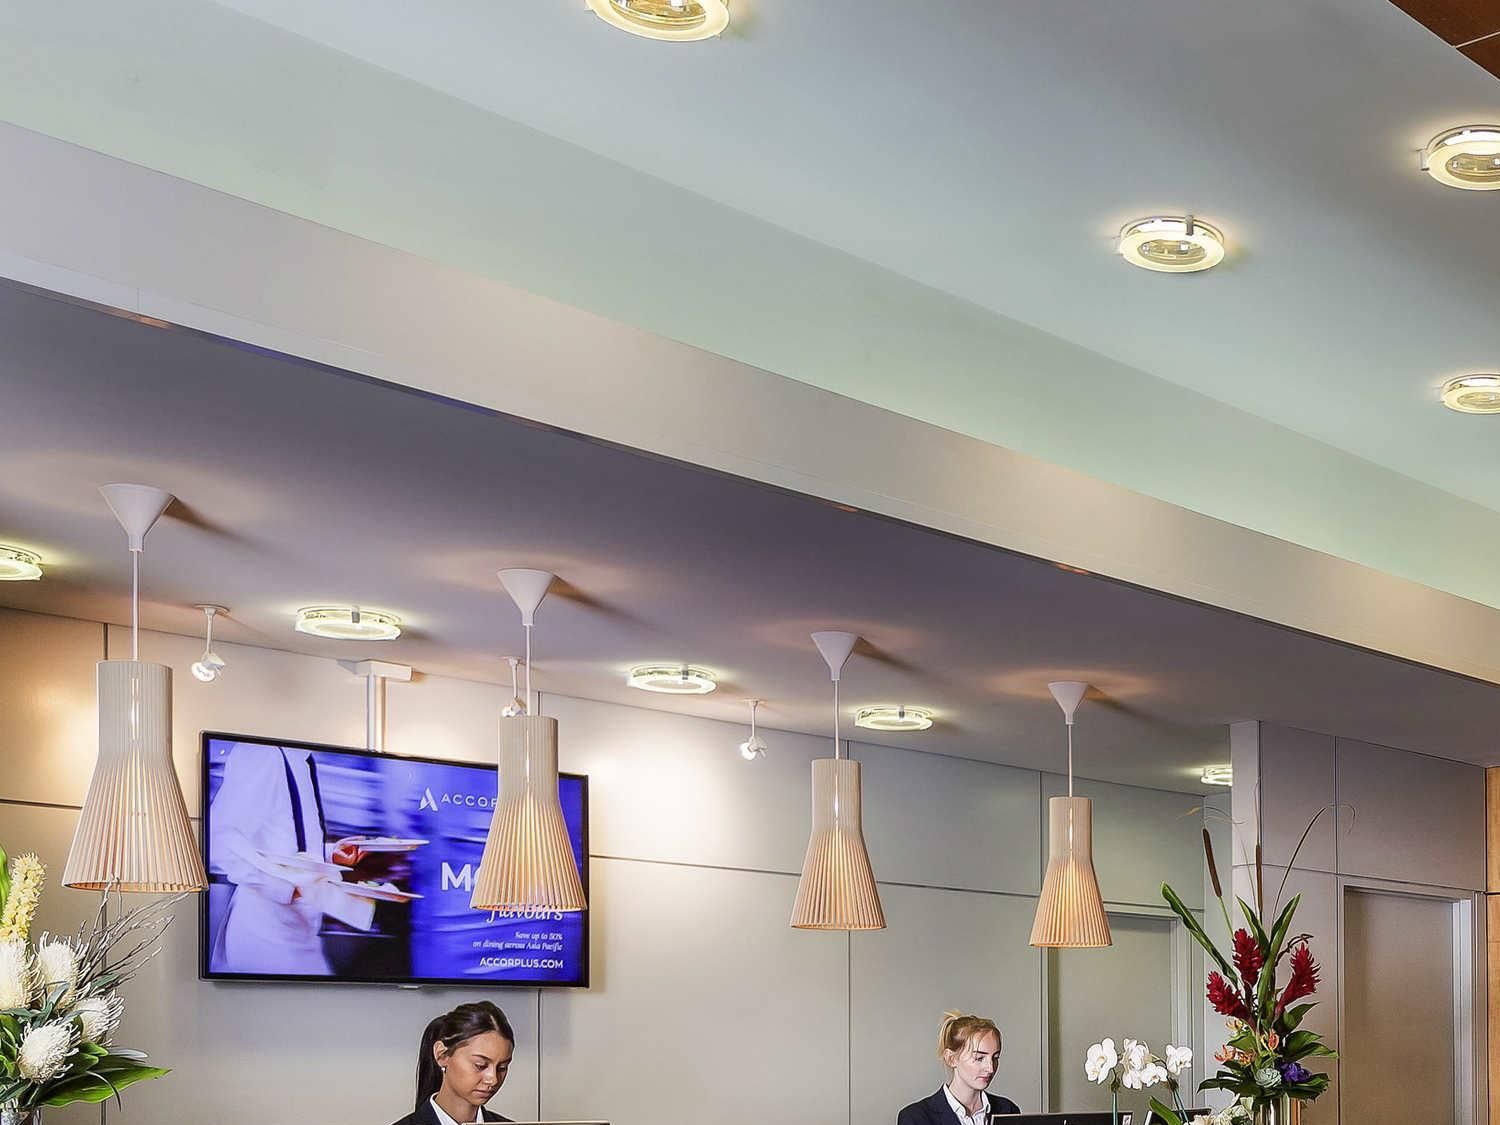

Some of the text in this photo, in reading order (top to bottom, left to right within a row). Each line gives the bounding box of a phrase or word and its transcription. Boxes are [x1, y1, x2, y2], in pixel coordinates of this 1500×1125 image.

[526, 942, 541, 950] Asia
[542, 942, 563, 952] Pacific
[480, 957, 563, 969] ACCORPLUS.COM
